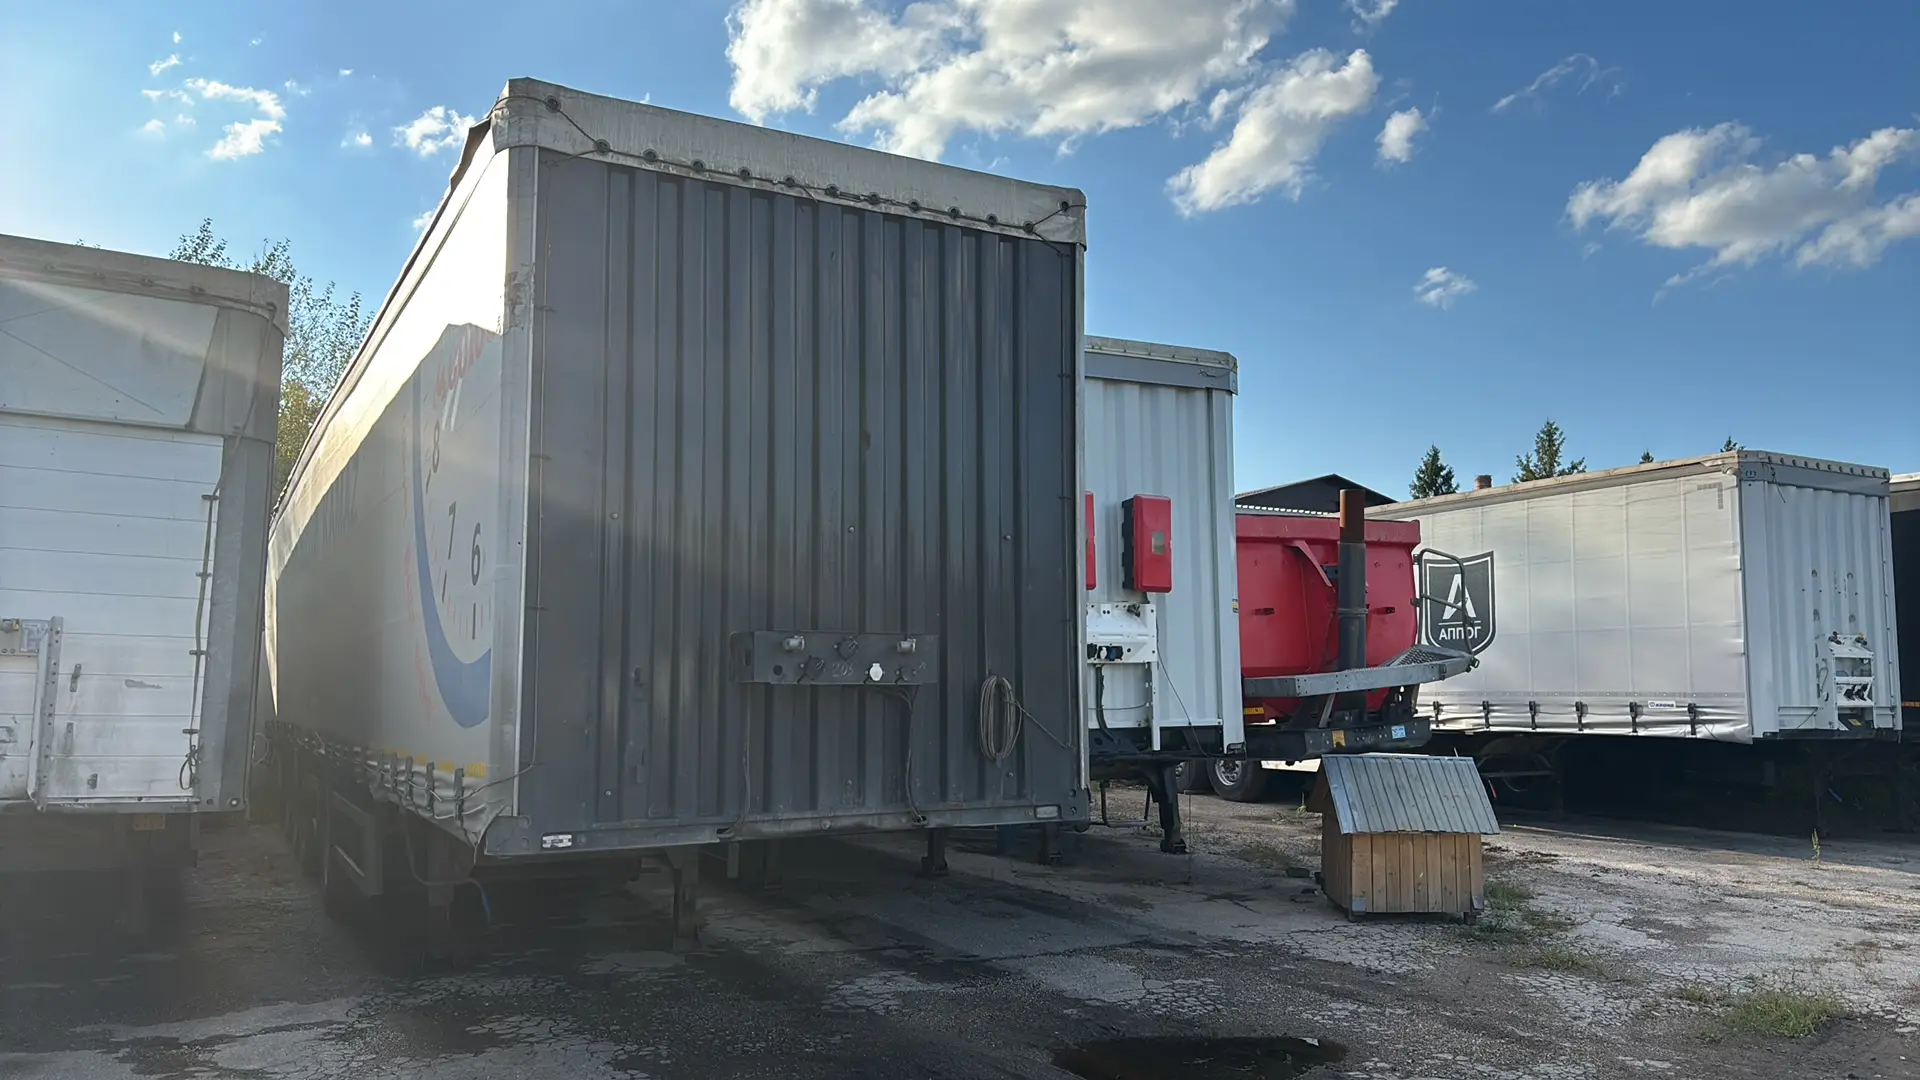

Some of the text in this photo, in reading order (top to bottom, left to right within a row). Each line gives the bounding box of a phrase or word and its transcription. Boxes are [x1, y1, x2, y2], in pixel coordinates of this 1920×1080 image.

[432, 420, 440, 474] 8
[448, 501, 457, 560] 7
[471, 522, 481, 586] 6
